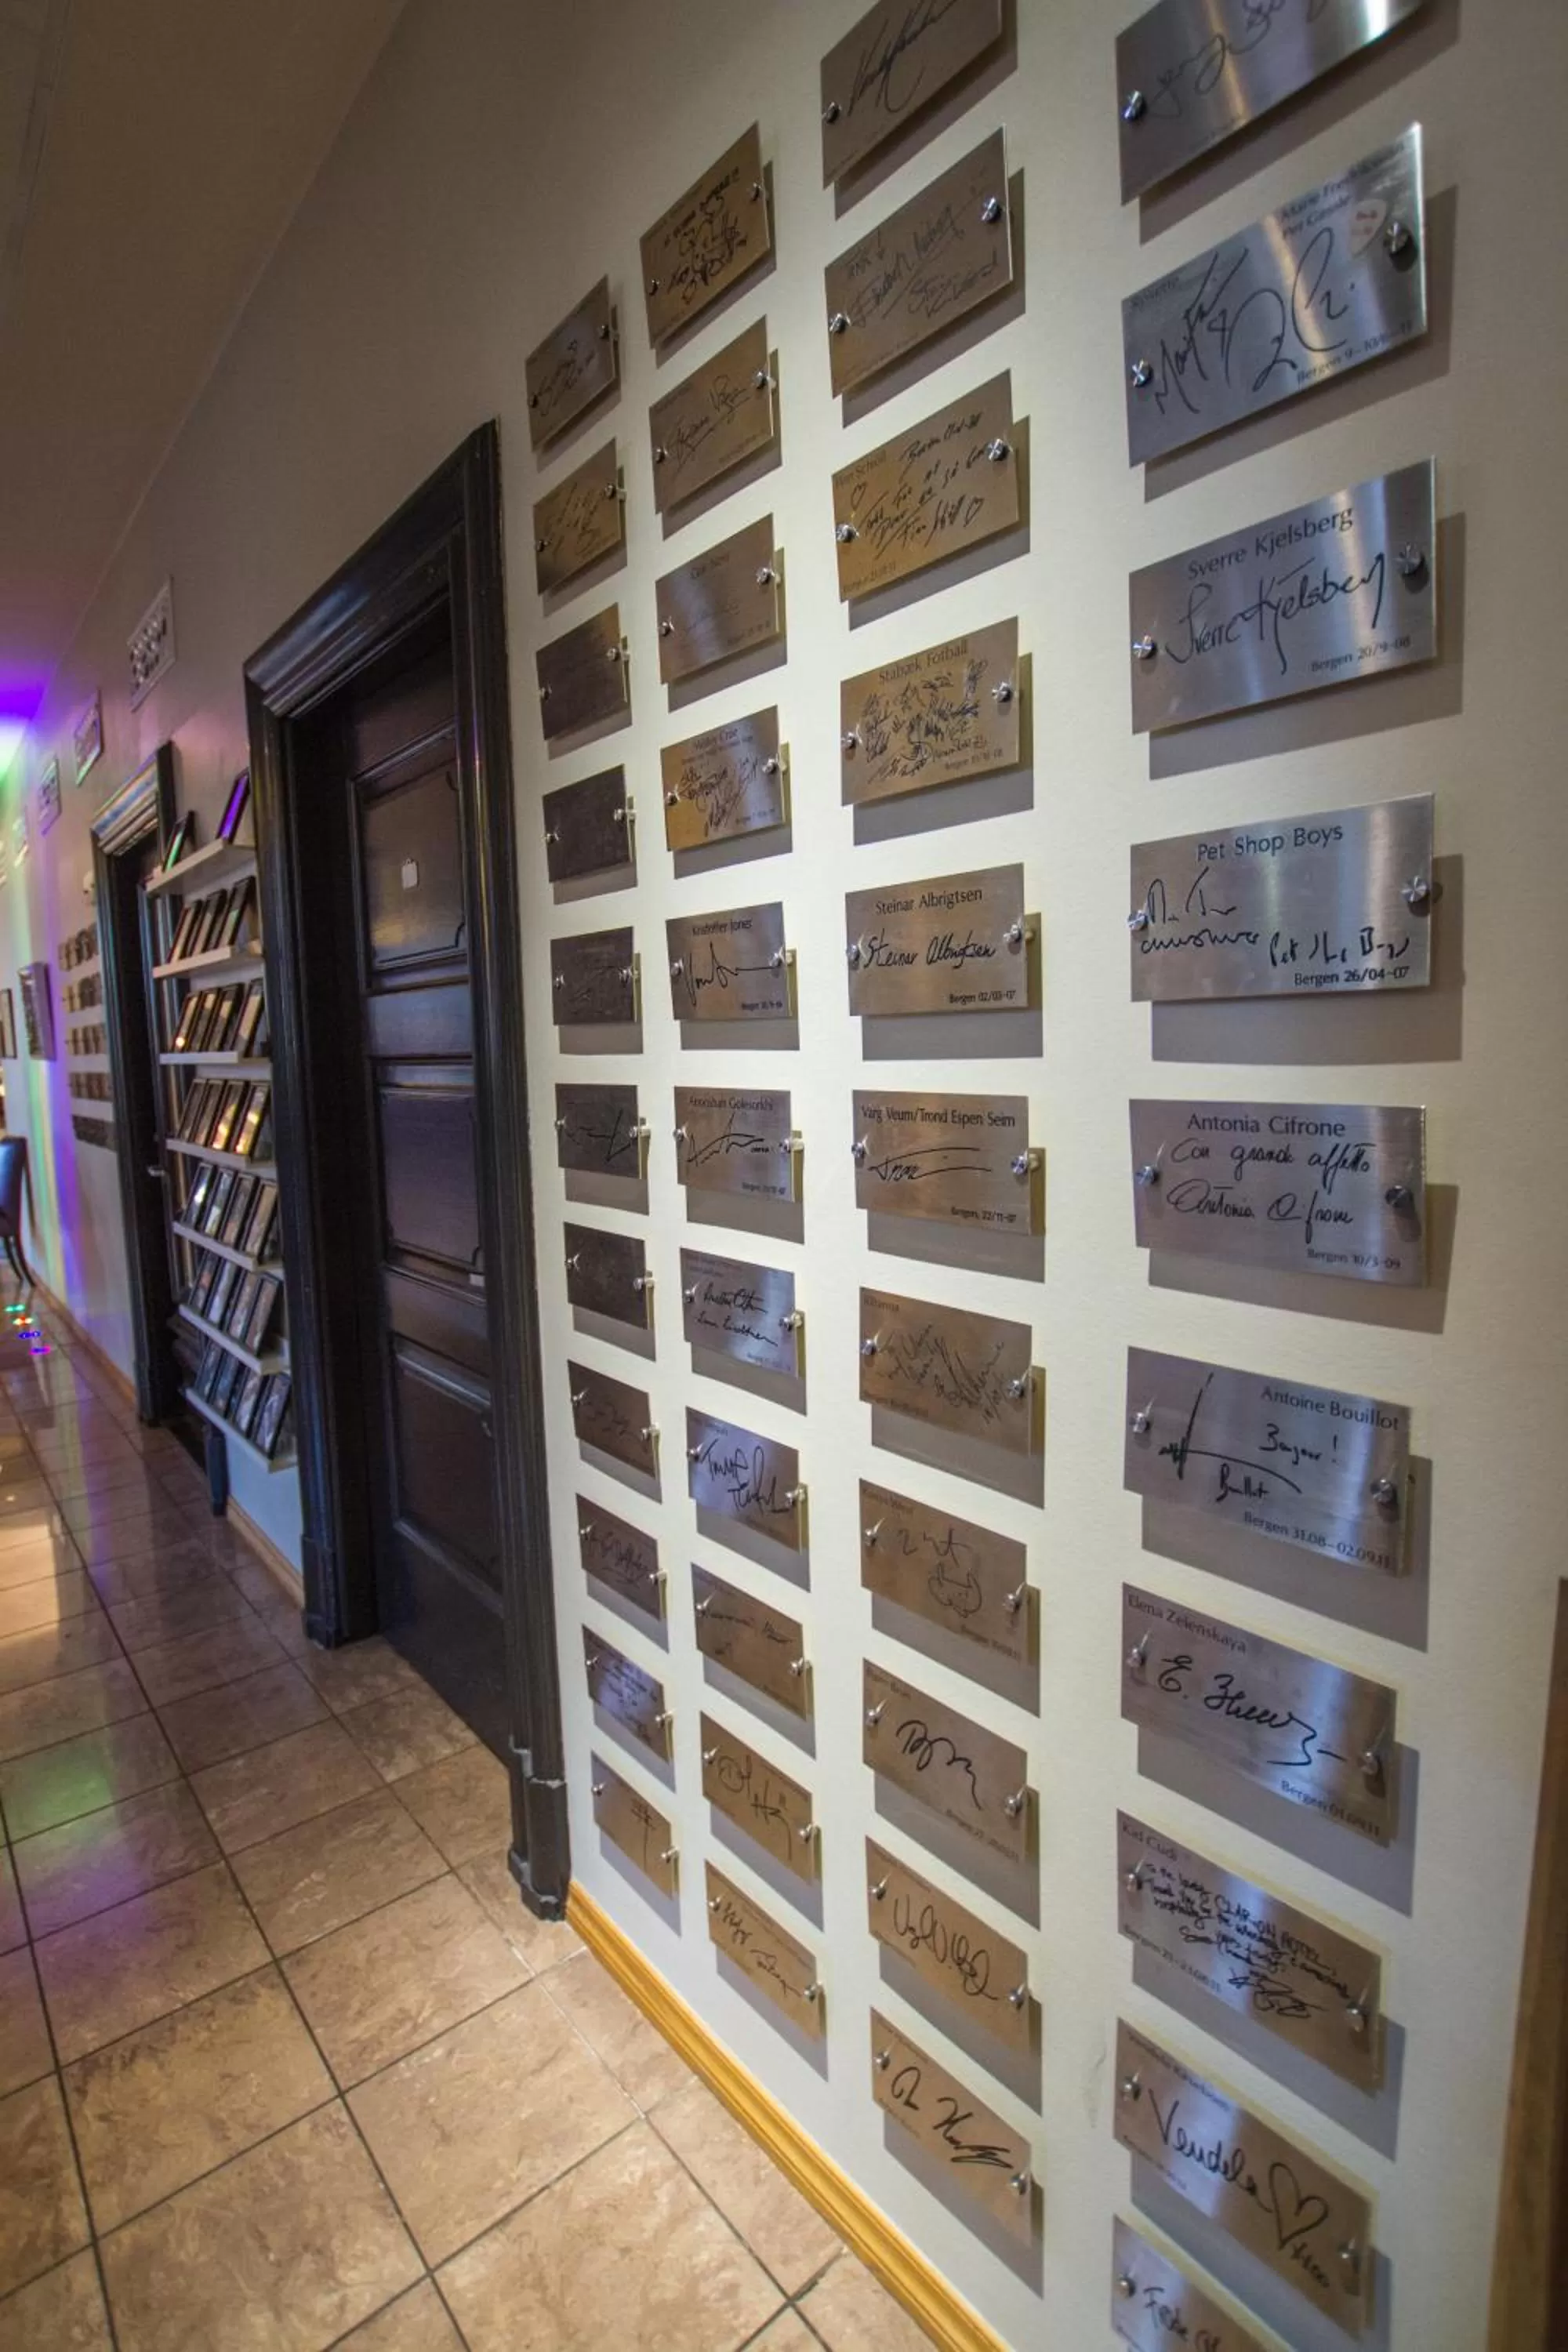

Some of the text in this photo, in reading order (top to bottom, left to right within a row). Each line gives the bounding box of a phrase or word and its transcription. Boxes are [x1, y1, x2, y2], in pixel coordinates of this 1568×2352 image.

[1187, 507, 1353, 581] Sverre Kjelsberg
[1197, 825, 1343, 862] Pet Shop Boys
[875, 888, 982, 916] Steinar Albrigtsen
[1294, 971, 1340, 988] Bergen
[949, 993, 976, 1005] Bergen
[862, 1106, 883, 1123] Varg
[951, 1110, 982, 1130] Espen
[987, 1112, 1016, 1127] Seim
[1187, 1113, 1346, 1137] Antonia Cifrone
[1260, 1385, 1400, 1431] Antoine Bouillot
[1243, 1512, 1290, 1535] Bergen
[1127, 1594, 1247, 1653] Elena Zelenskaya
[1148, 2088, 1273, 2213] Vendela
